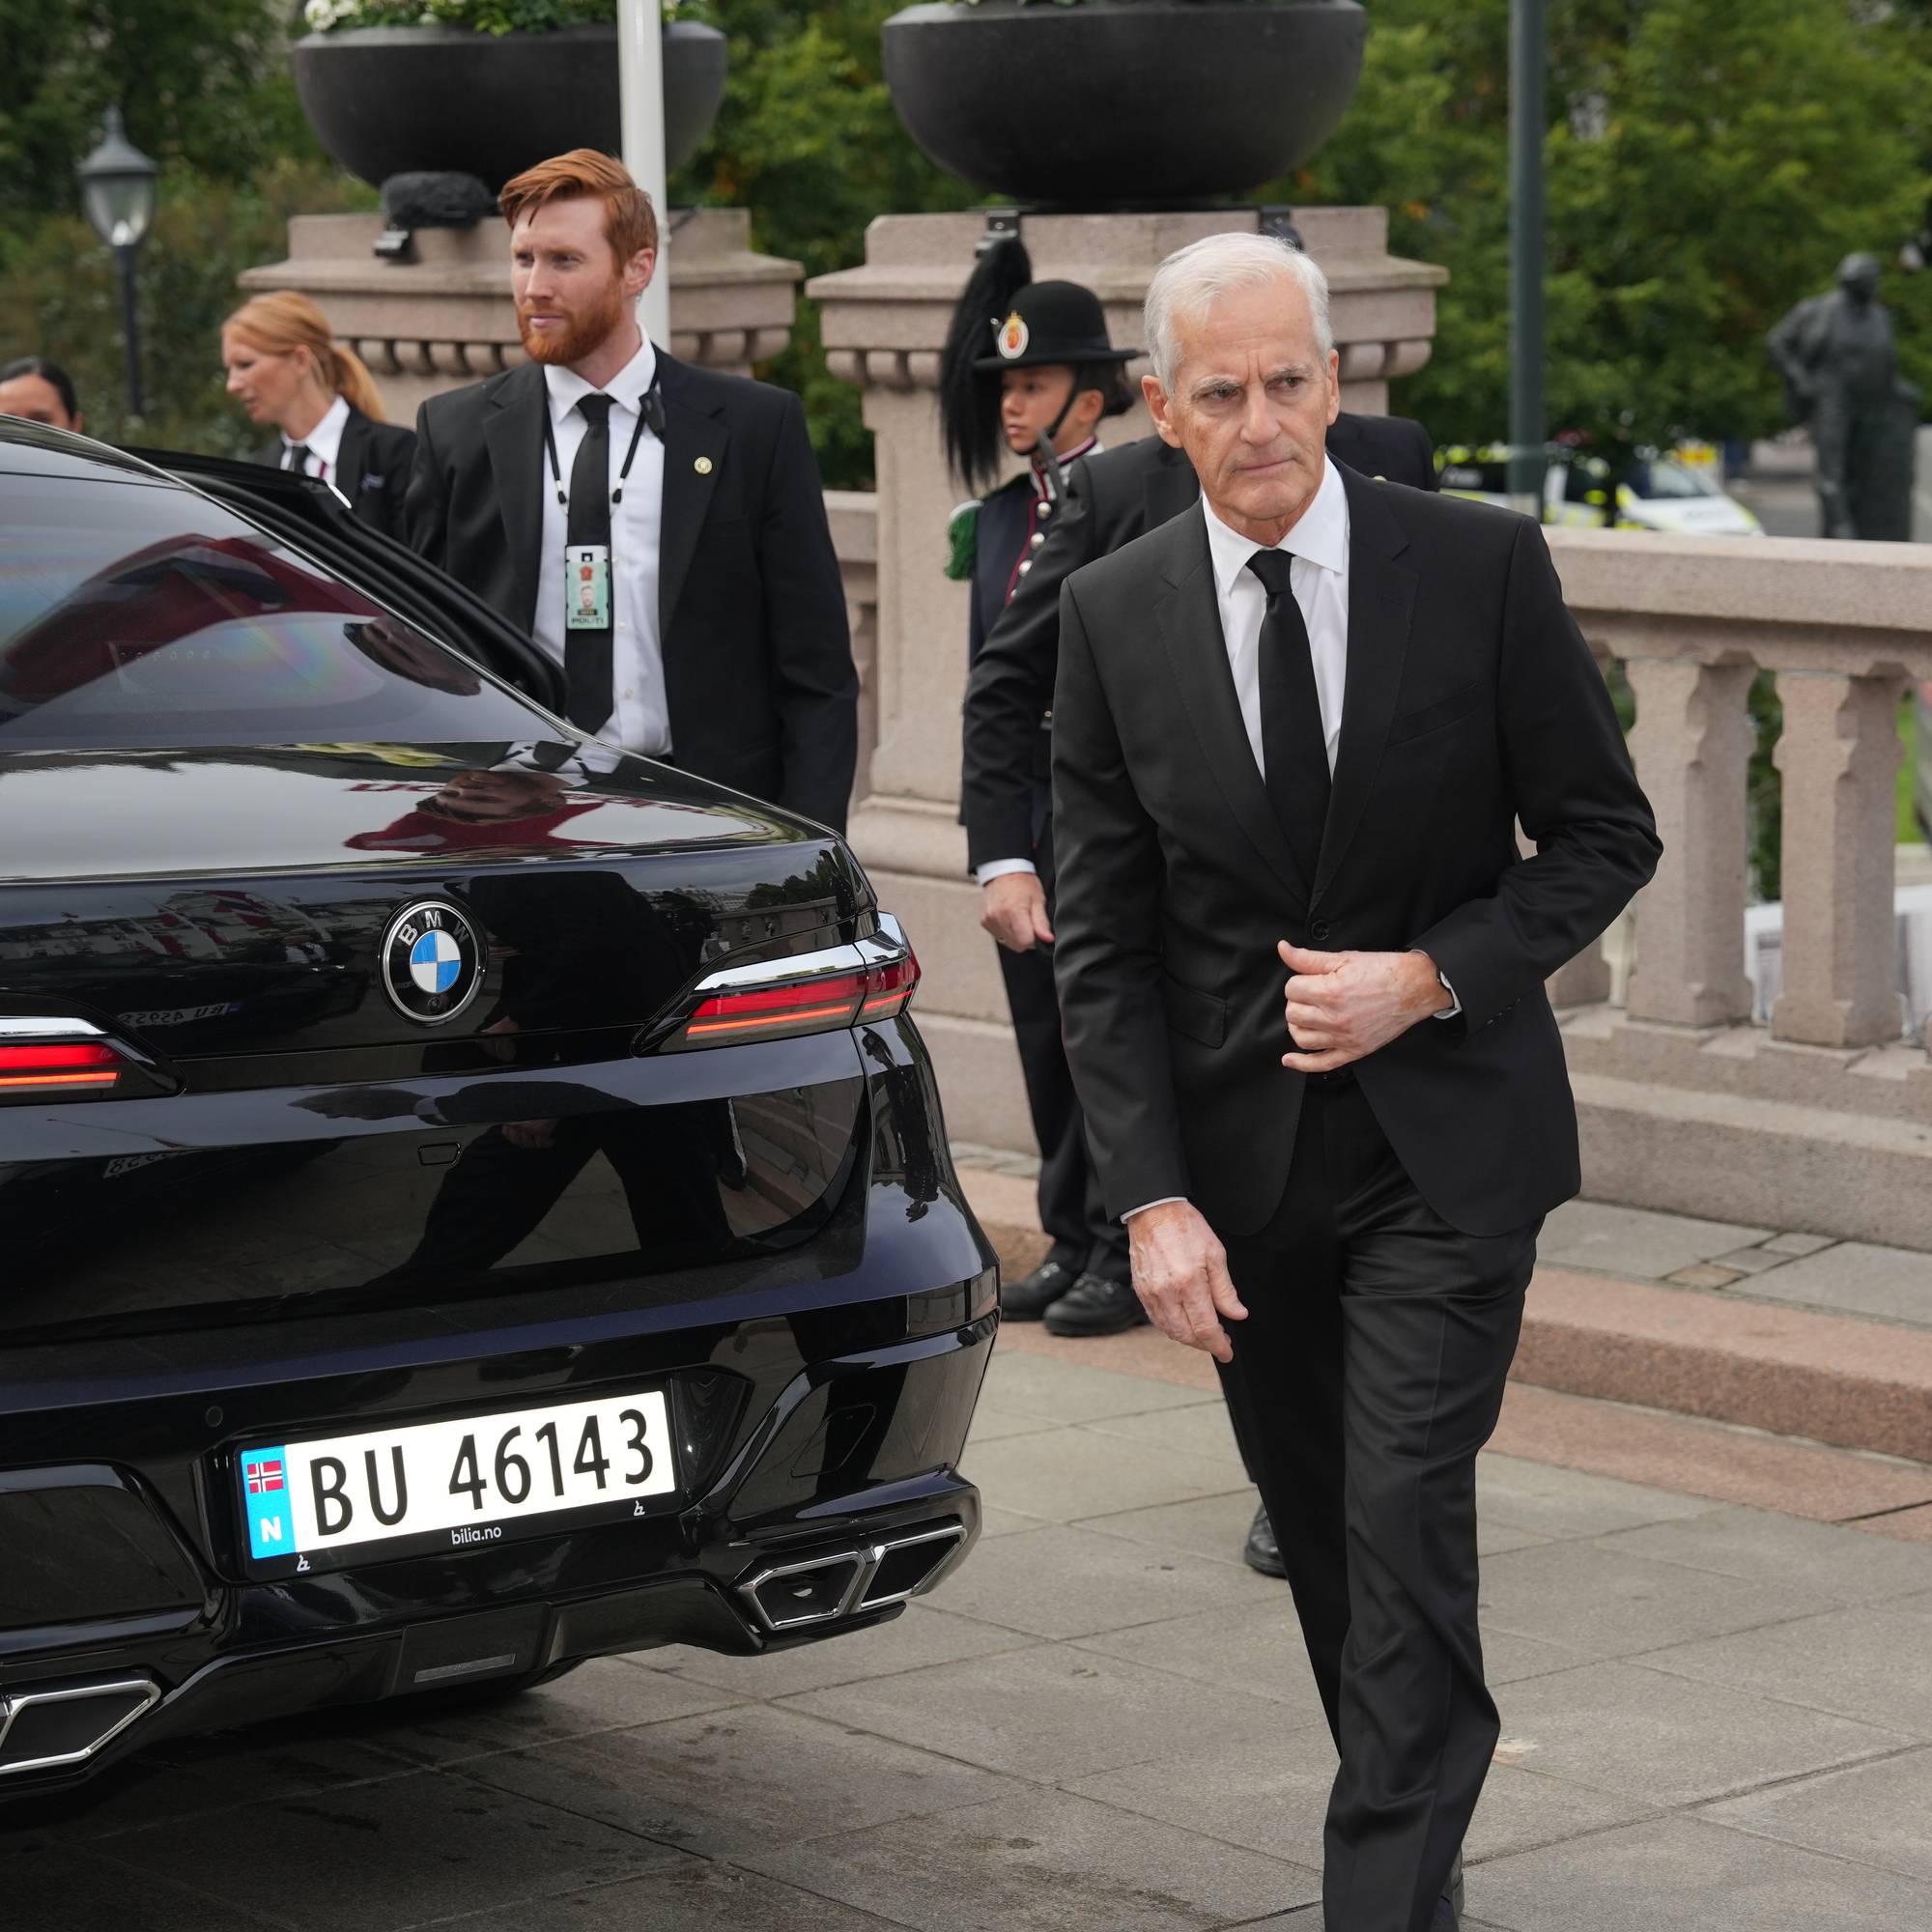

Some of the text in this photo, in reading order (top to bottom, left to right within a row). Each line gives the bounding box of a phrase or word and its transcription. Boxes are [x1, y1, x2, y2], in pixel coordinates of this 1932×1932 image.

[398, 910, 469, 947] BMW
[310, 1408, 654, 1537] BU 46143
[261, 1516, 282, 1543] N
[451, 1526, 502, 1546] bilia.no
